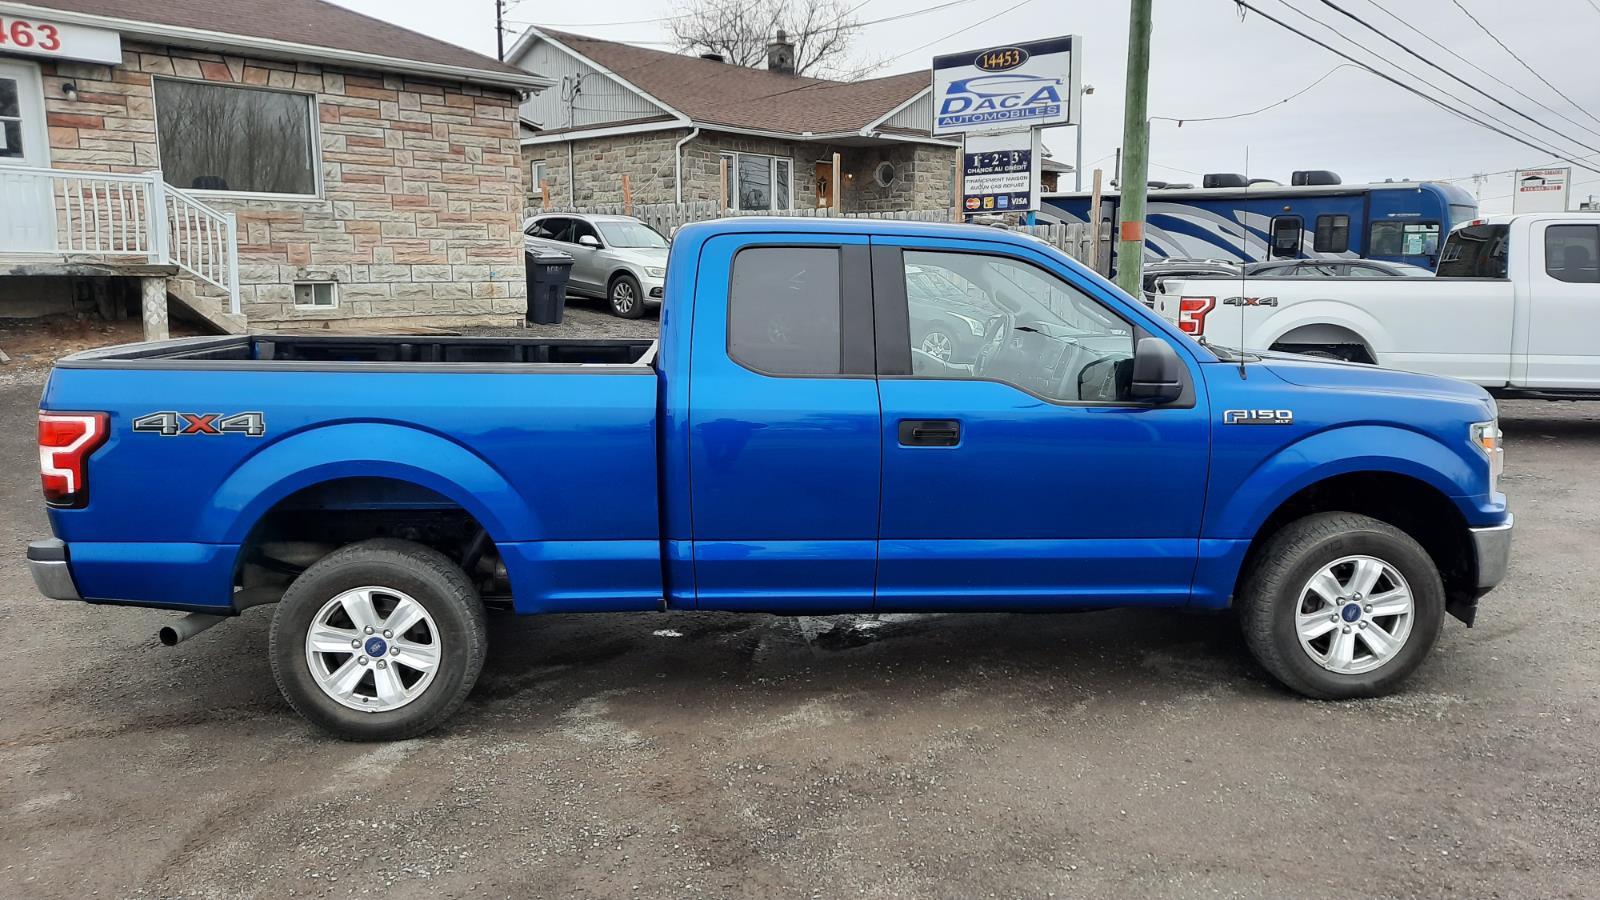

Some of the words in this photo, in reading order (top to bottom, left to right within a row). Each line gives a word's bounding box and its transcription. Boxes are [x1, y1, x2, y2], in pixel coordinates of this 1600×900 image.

[983, 50, 1020, 69] 14453
[940, 86, 1061, 115] DACA
[942, 106, 1057, 124] AUTOMOBILES
[1011, 197, 1028, 205] VISA
